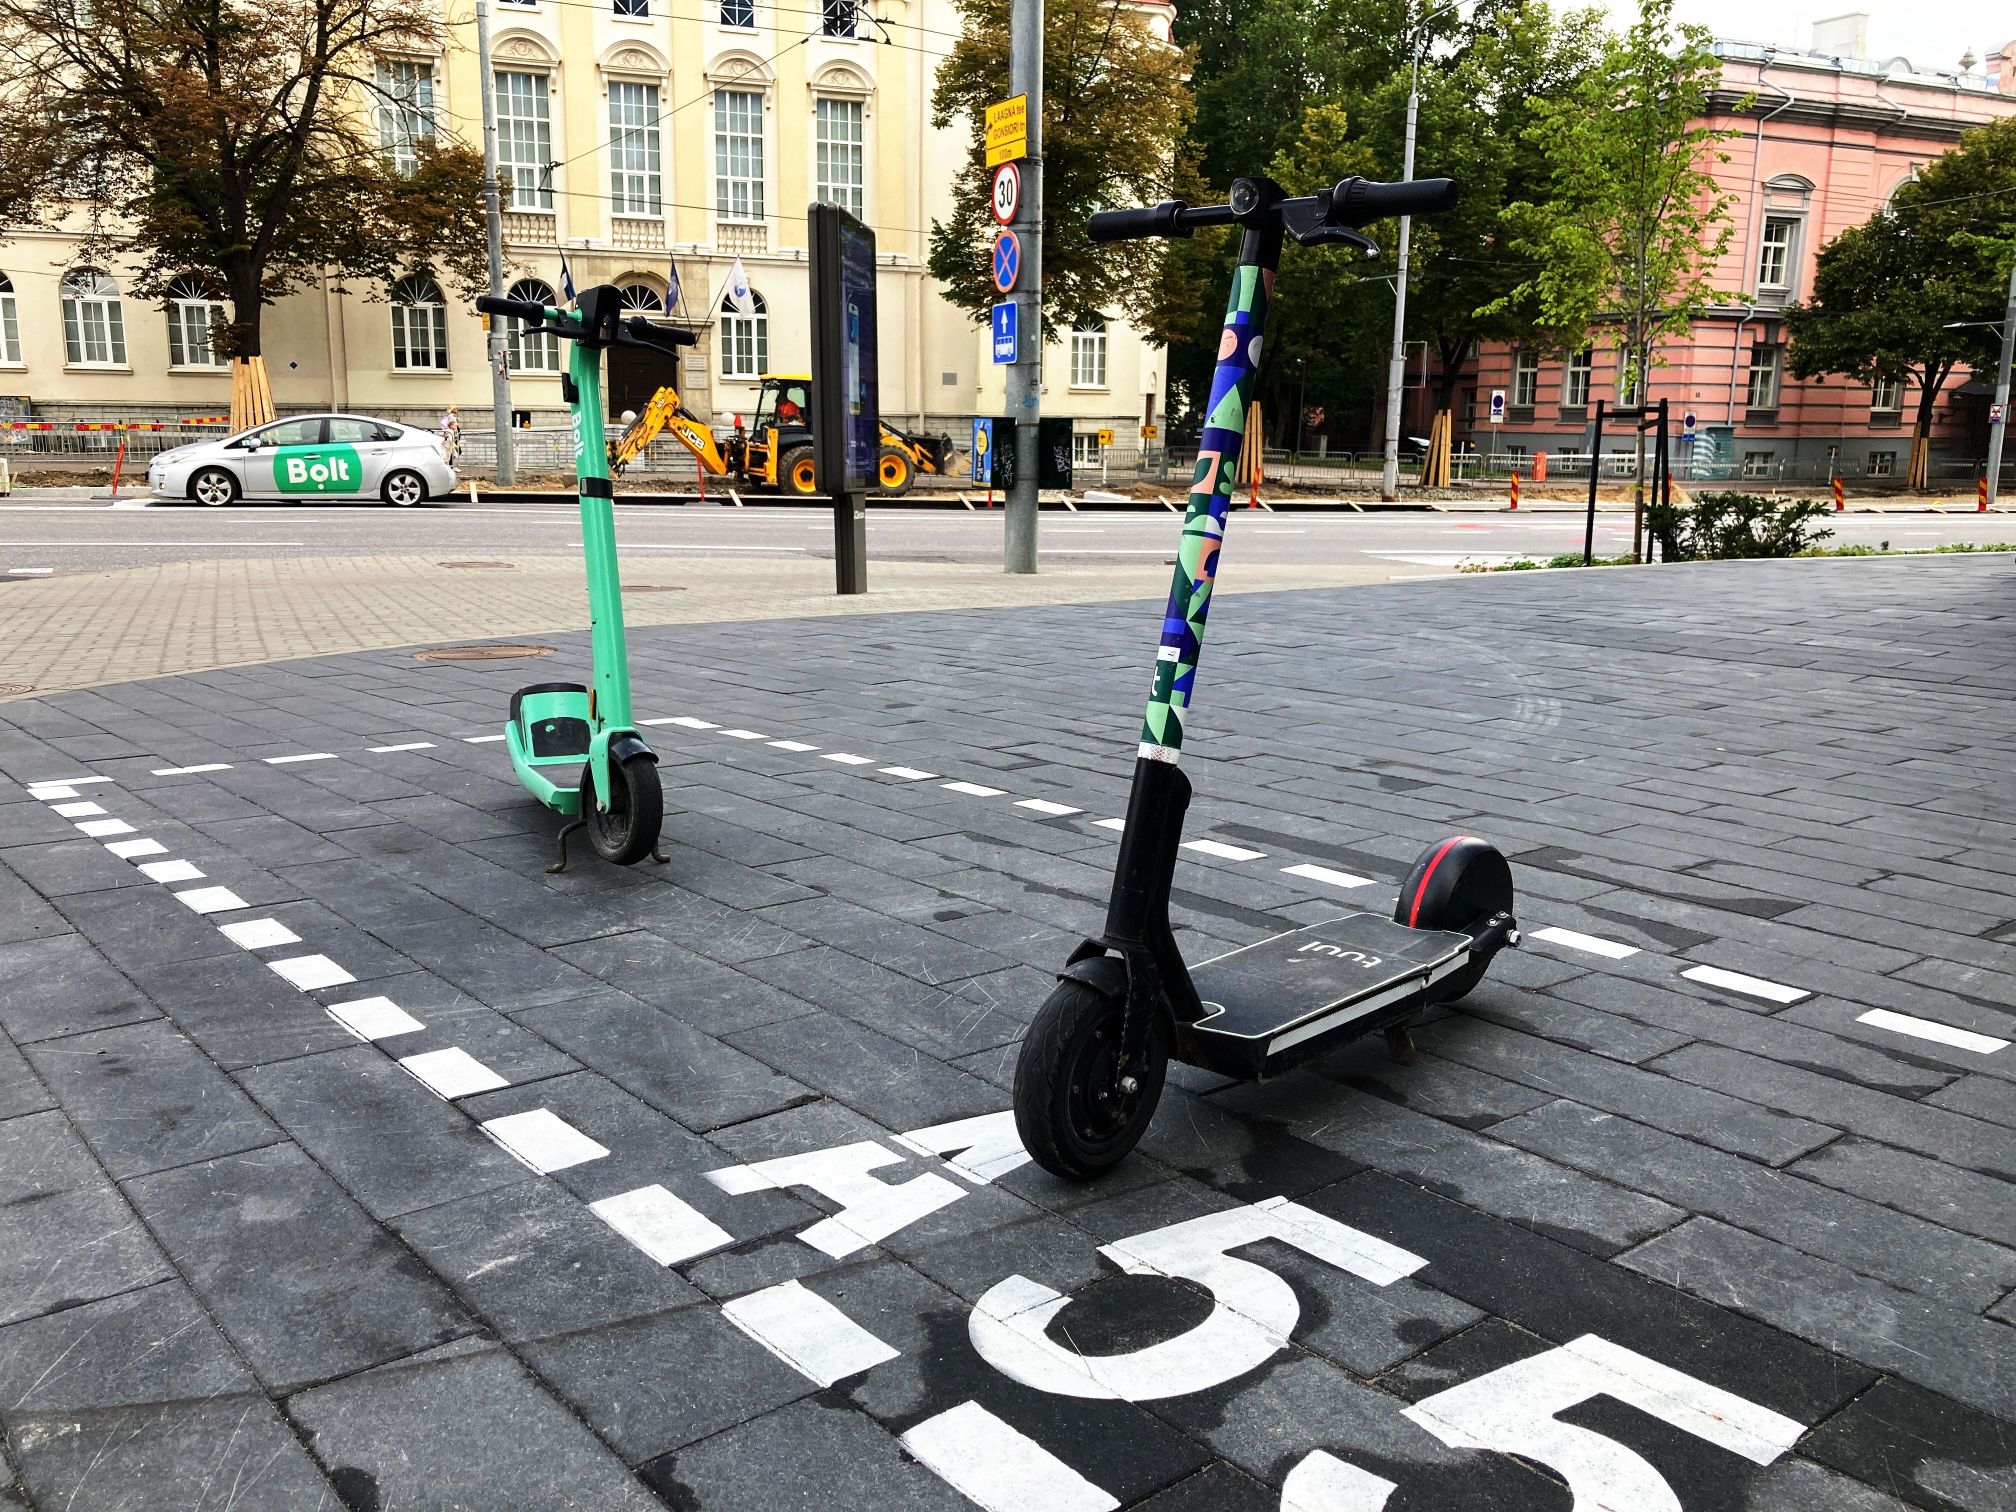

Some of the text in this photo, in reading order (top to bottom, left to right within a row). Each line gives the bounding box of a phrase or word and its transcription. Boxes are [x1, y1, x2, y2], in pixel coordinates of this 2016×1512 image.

[993, 104, 1025, 123] LAAGNA tee
[993, 122, 1019, 140] GONSIORI
[998, 179, 1013, 208] 30
[572, 411, 584, 459] Bolt
[681, 427, 705, 450] JCB
[287, 456, 349, 486] Bolt
[1297, 941, 1382, 968] tuul
